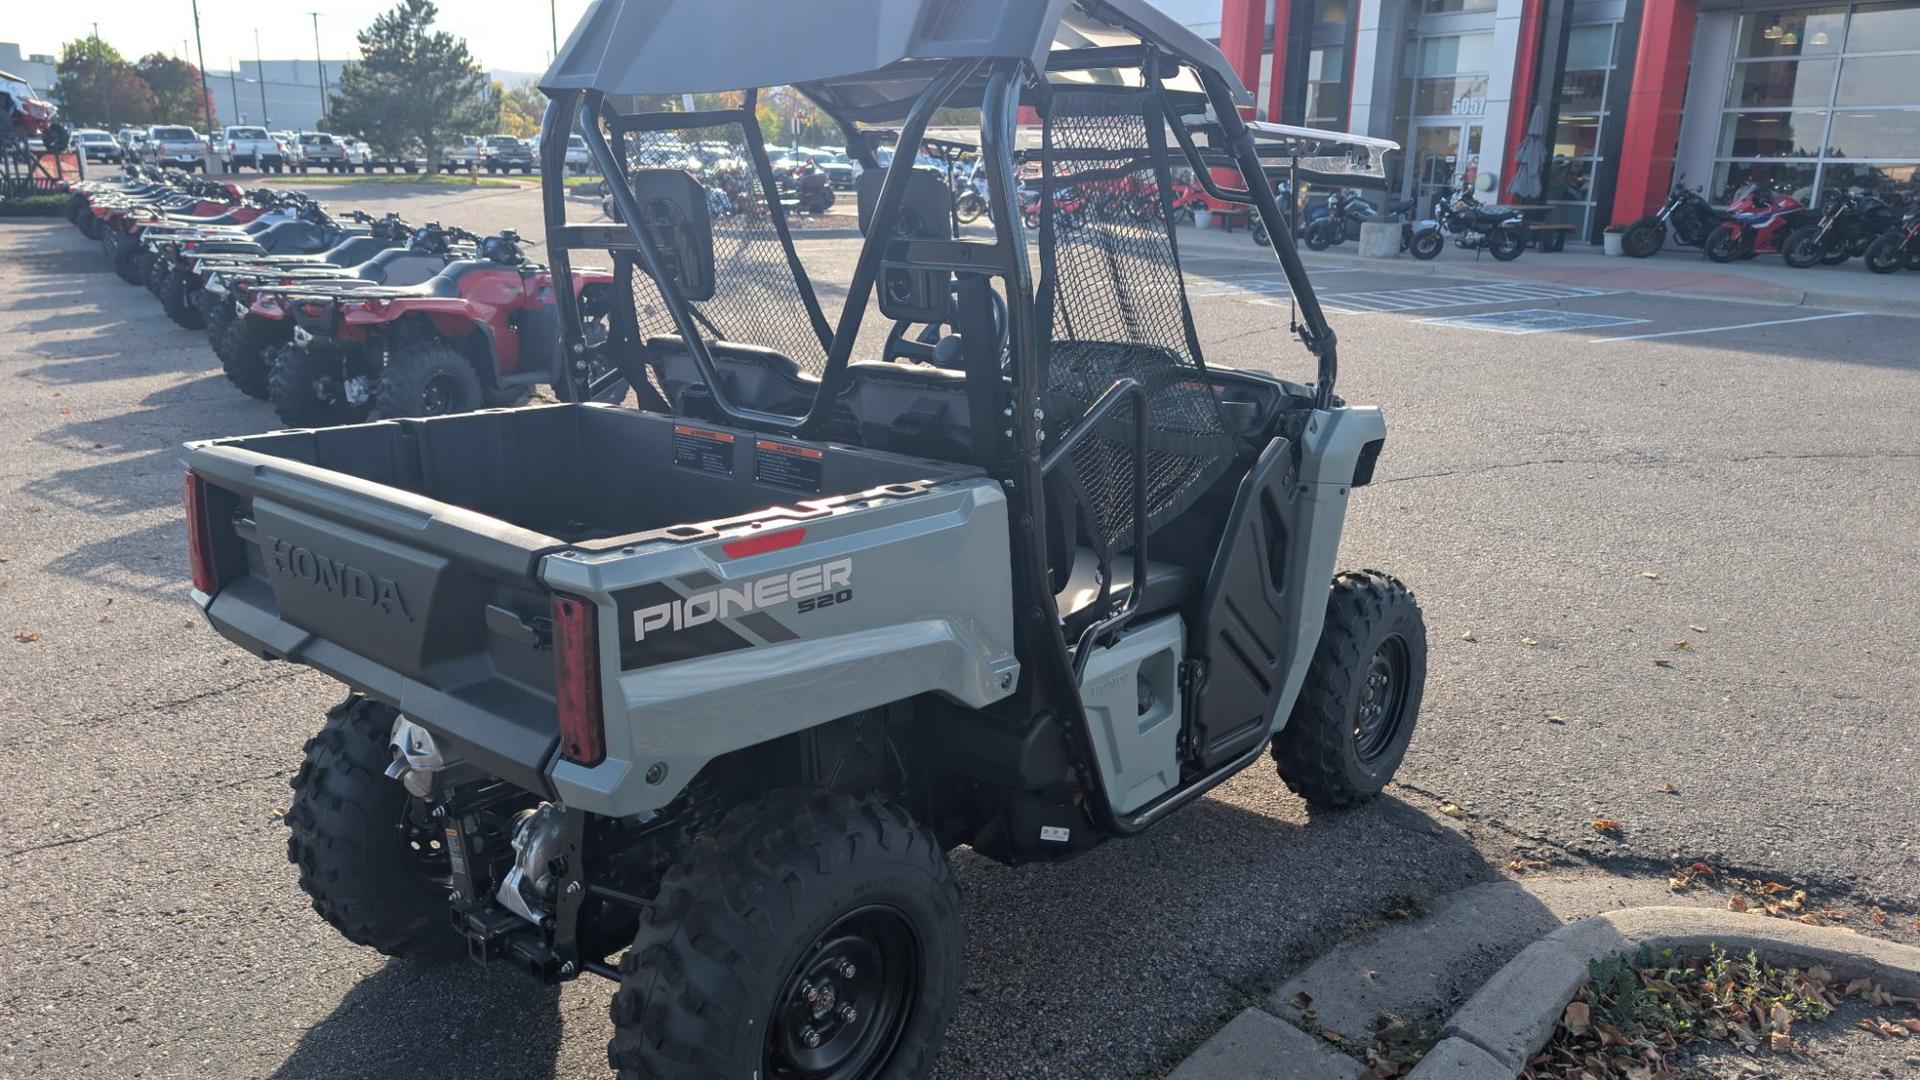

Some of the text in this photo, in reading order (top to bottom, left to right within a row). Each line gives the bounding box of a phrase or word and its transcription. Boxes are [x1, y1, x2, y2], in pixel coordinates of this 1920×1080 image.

[268, 535, 415, 622] HONDA
[633, 557, 853, 642] PIONEER
[798, 589, 853, 614] 520
